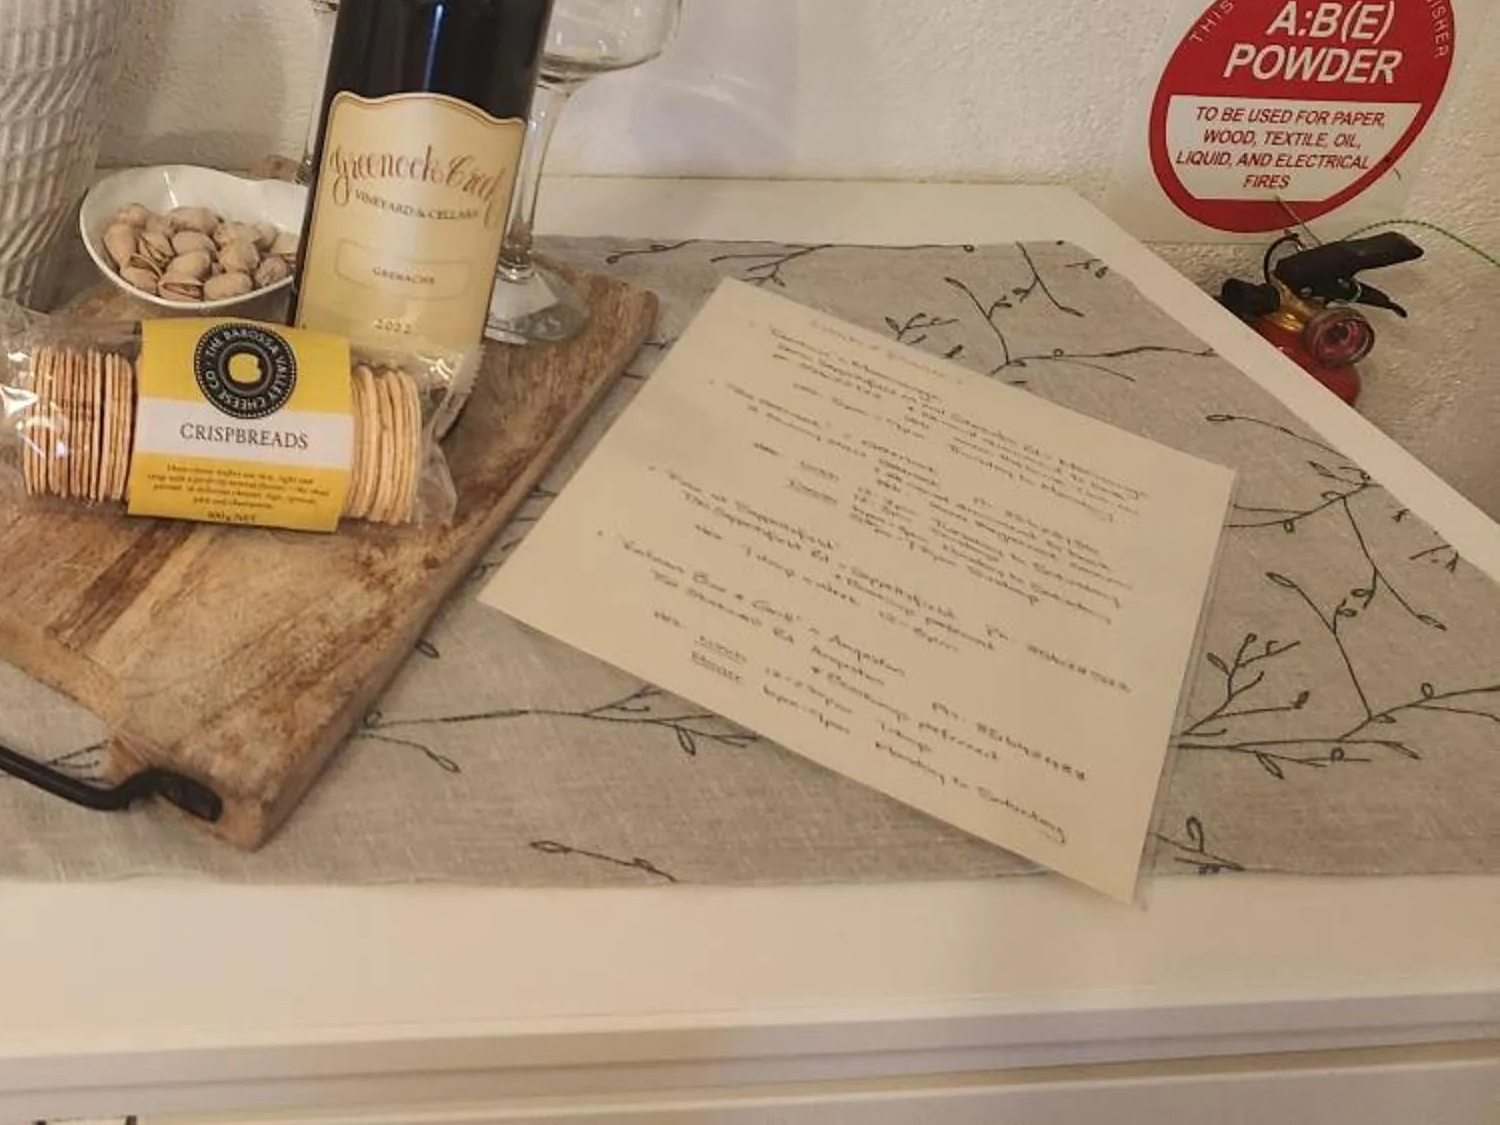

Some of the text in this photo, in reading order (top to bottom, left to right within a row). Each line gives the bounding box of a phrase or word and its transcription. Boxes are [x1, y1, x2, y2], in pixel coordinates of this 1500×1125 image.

[1189, 0, 1235, 43] THIS
[1222, 43, 1403, 85] POWDER
[1196, 106, 1218, 122] TO
[1221, 106, 1245, 123] BE
[1247, 108, 1293, 124] USED
[1294, 109, 1331, 125] FOR
[1202, 128, 1362, 149] WOOD, TEXTILE, OIL,
[1175, 150, 1370, 171] LIQUID, AND ELECTRICAL
[1243, 174, 1291, 190] FIRES
[205, 335, 224, 357] THE
[223, 328, 279, 355] BAROSSA
[268, 355, 289, 404] VALLEY
[218, 389, 267, 412] CHEESE
[179, 422, 310, 450] CRISPBREADS
